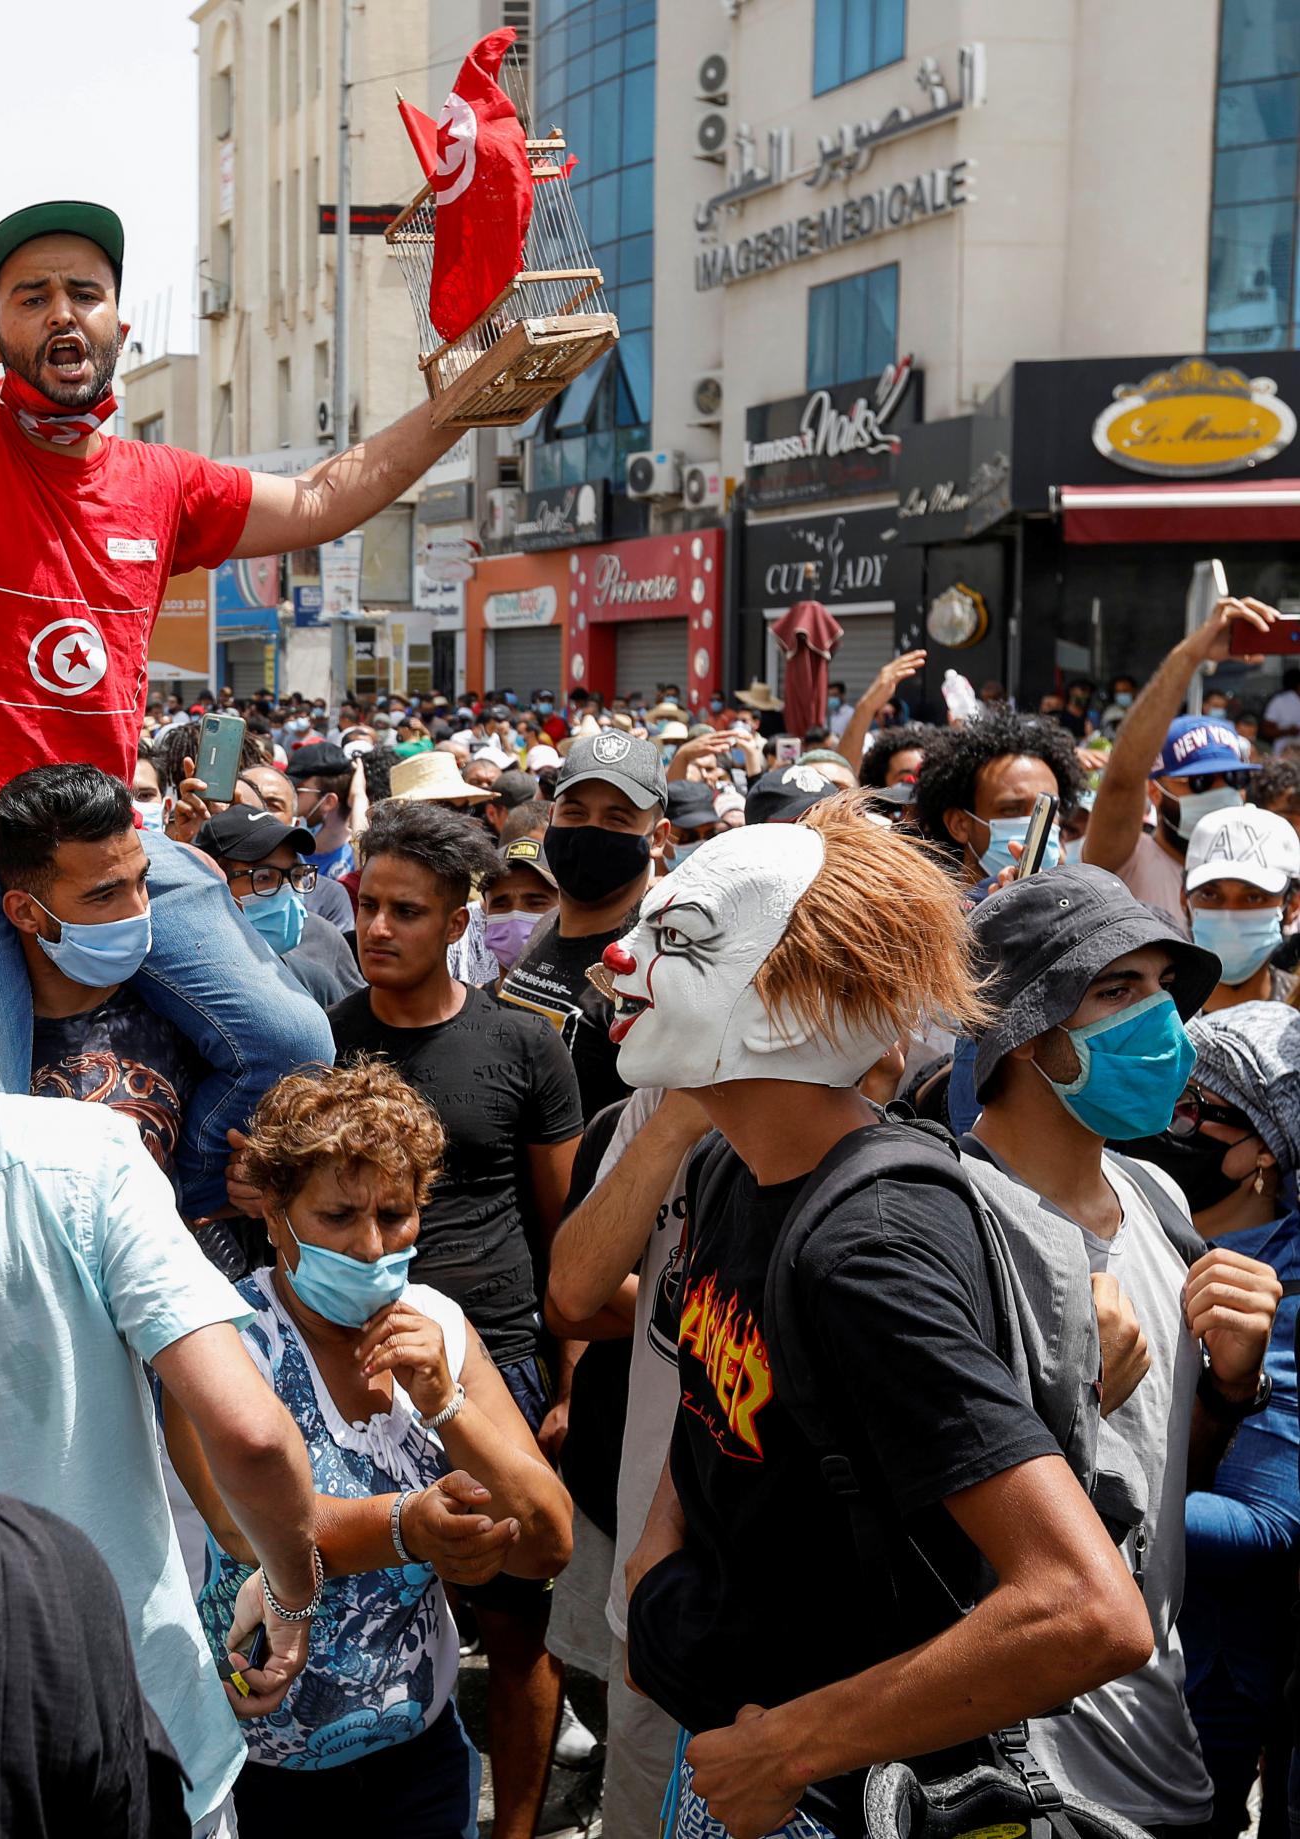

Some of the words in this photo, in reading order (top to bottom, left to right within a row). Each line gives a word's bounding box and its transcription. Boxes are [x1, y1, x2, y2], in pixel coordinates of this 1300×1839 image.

[695, 216, 815, 292] IMAGERIE
[818, 157, 980, 252] MEDICALE
[592, 552, 679, 608] Princesse
[1172, 726, 1208, 763] NEW
[1203, 823, 1272, 869] AX
